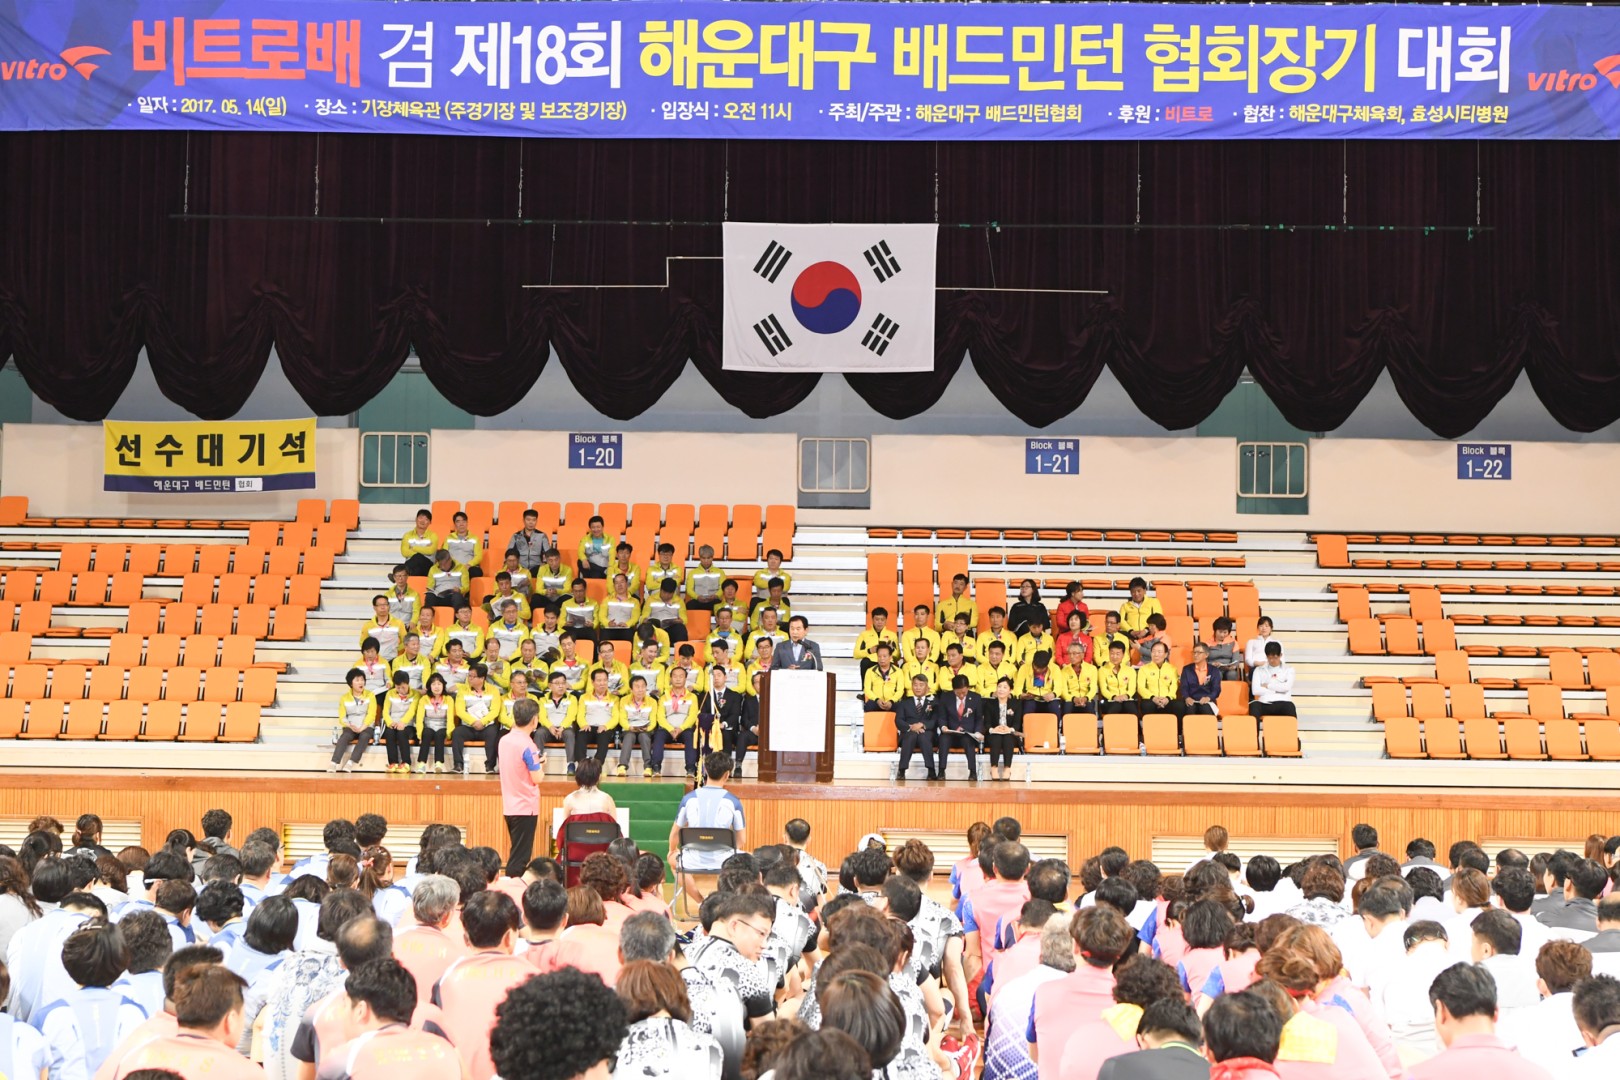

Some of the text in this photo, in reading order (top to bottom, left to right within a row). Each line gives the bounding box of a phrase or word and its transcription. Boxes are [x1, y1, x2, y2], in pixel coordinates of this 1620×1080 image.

[132, 17, 1512, 94] 비트로배 겸 제18회 해운대구 배드민턴 협회장기 대회
[1, 60, 68, 81] vitro
[1527, 71, 1598, 92] vitro
[361, 98, 441, 118] 기장체육관
[444, 100, 516, 121] (주경기장
[519, 101, 536, 121] 및
[539, 100, 627, 121] 보조경기장)
[722, 102, 756, 121] 오전
[760, 102, 792, 122] 11시
[915, 103, 981, 123] 해운대구
[985, 103, 1082, 123] 배드민턴협회
[1164, 105, 1214, 124] 비트로
[1409, 105, 1509, 125] 효성시티병원
[114, 430, 307, 468] 선수대기석
[574, 434, 597, 444] Block
[1030, 441, 1053, 450] Block
[578, 447, 615, 467] 1-20
[1462, 446, 1485, 455] Block
[1035, 453, 1069, 473] 1-21
[1466, 459, 1503, 478] 1-22
[153, 479, 190, 491] 해운대구
[194, 479, 231, 491] 배드민턴
